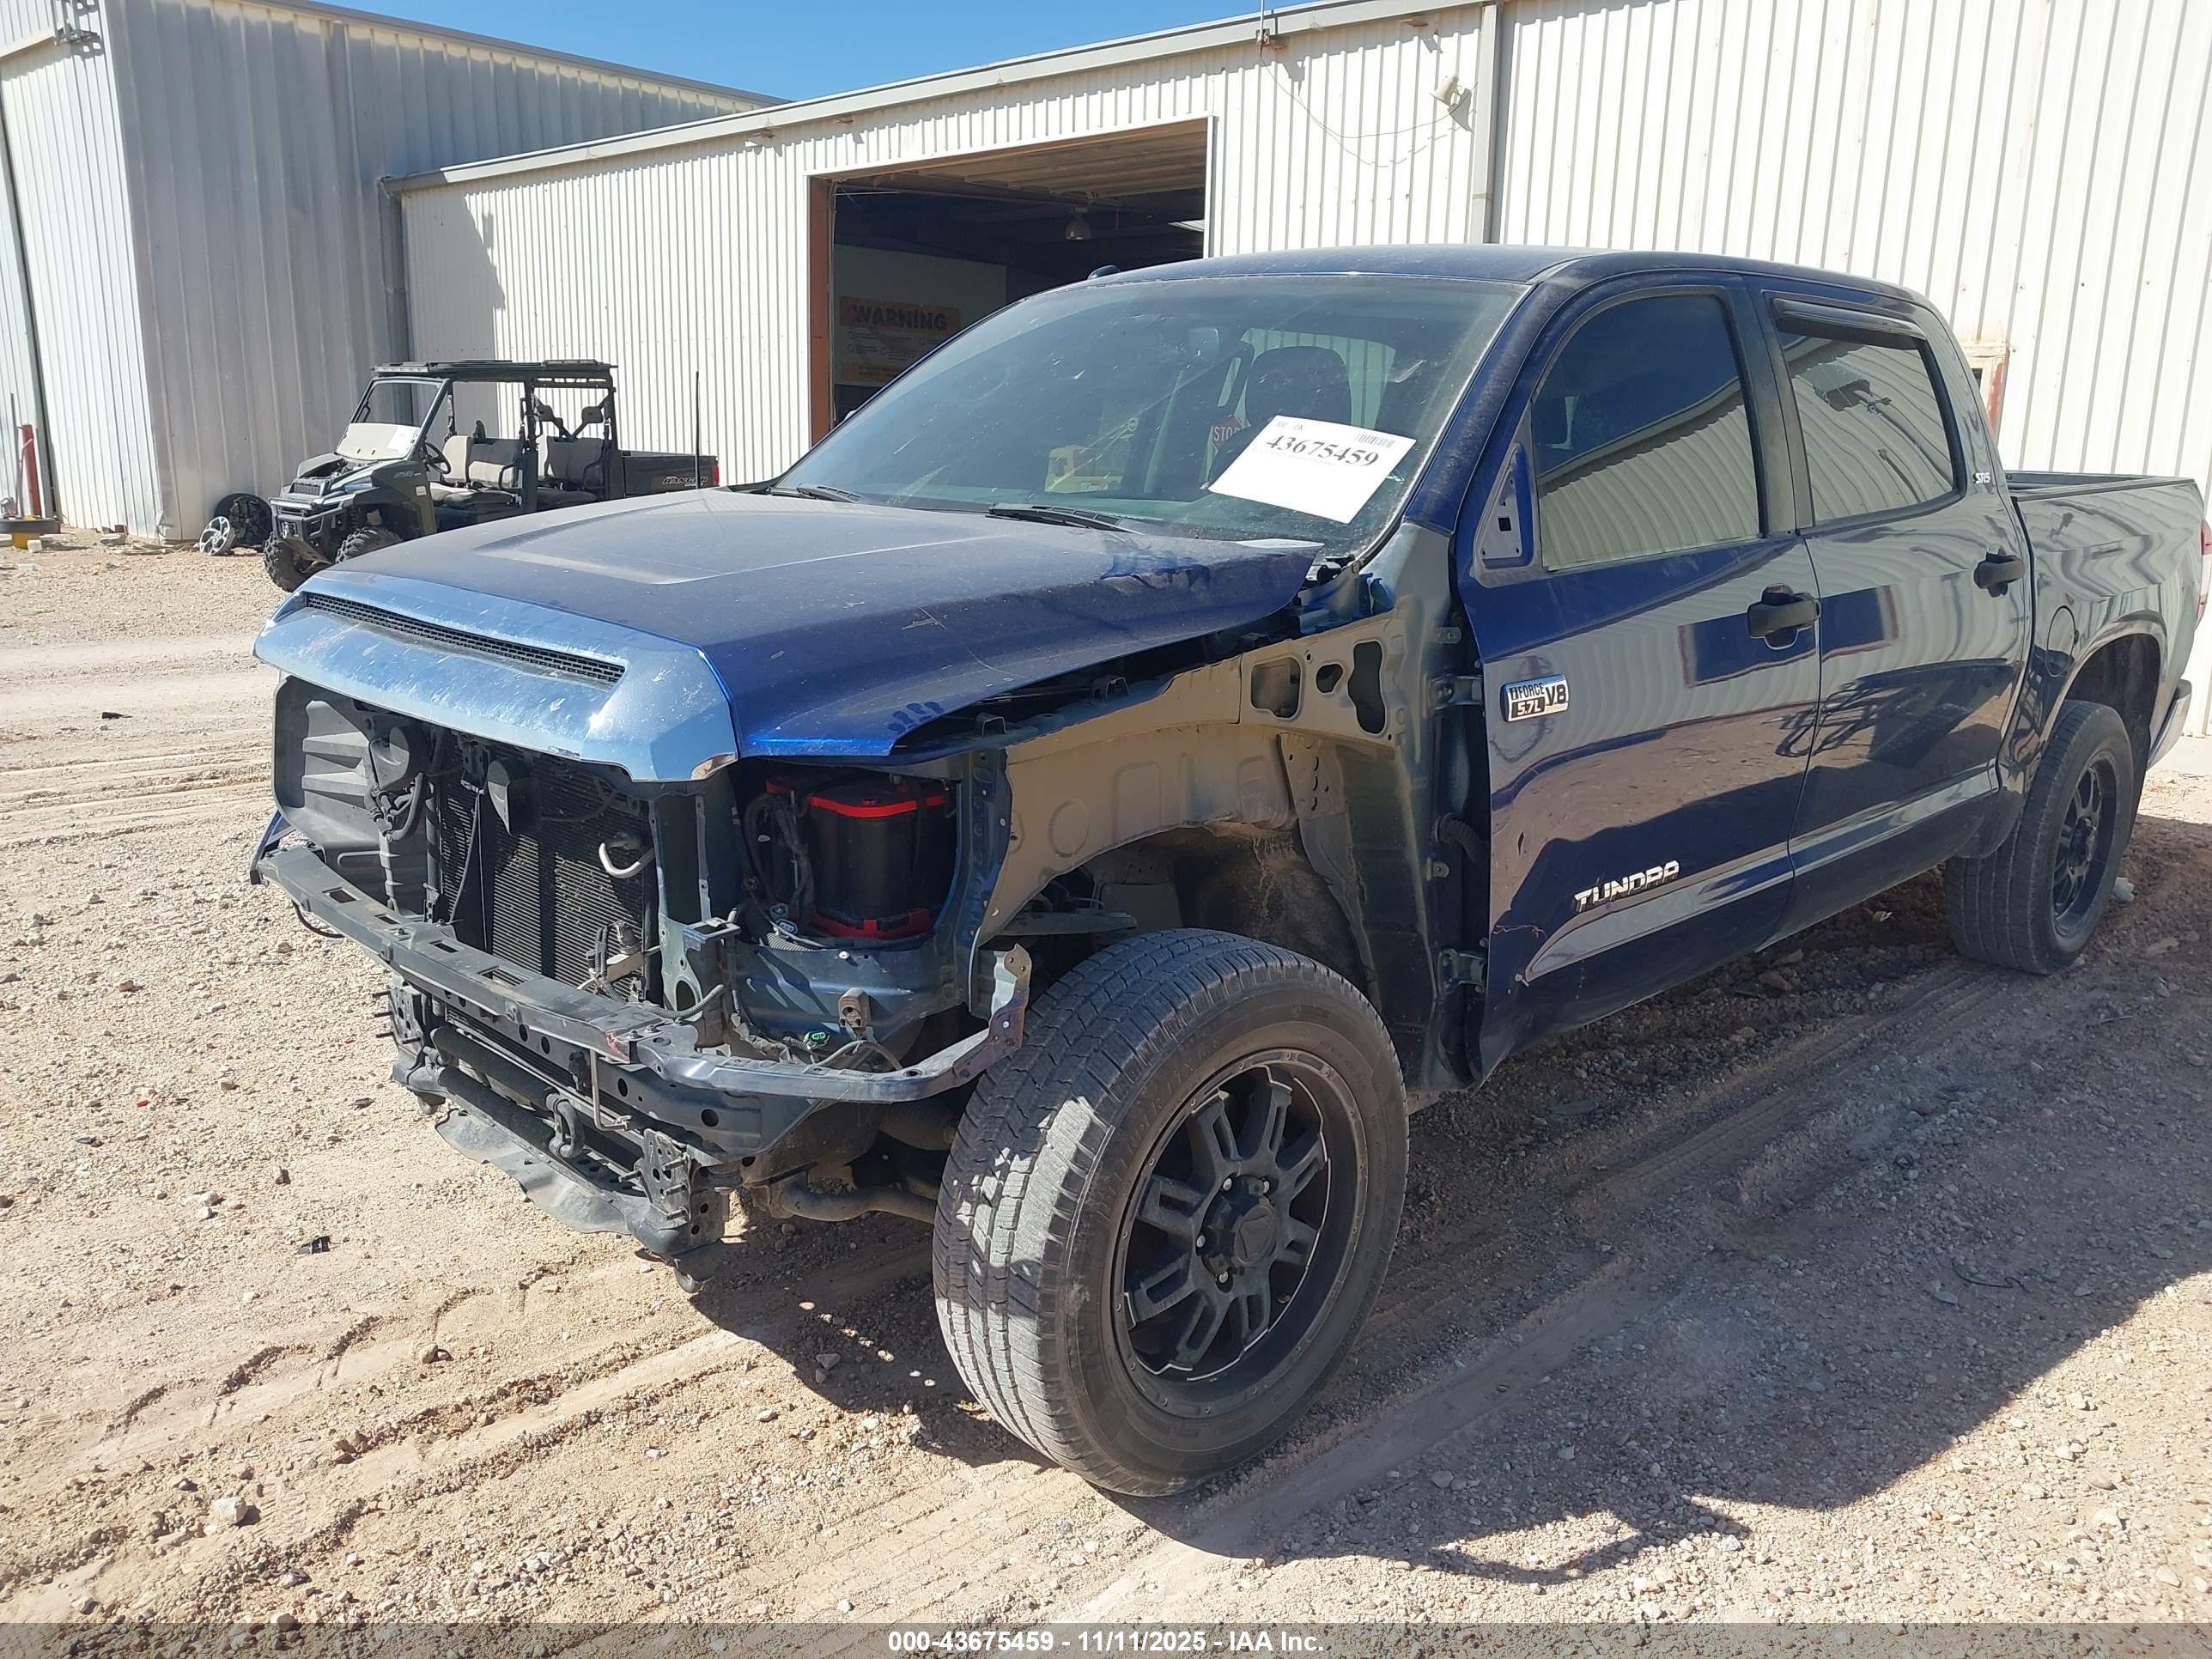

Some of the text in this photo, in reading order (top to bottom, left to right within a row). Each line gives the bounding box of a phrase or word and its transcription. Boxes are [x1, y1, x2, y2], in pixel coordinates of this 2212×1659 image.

[852, 304, 948, 331] WARNING
[1267, 434, 1379, 466] 43675459
[1516, 699, 1541, 715] 5.7L
[1546, 684, 1566, 706] V8
[1574, 860, 1680, 912] TUNDRA
